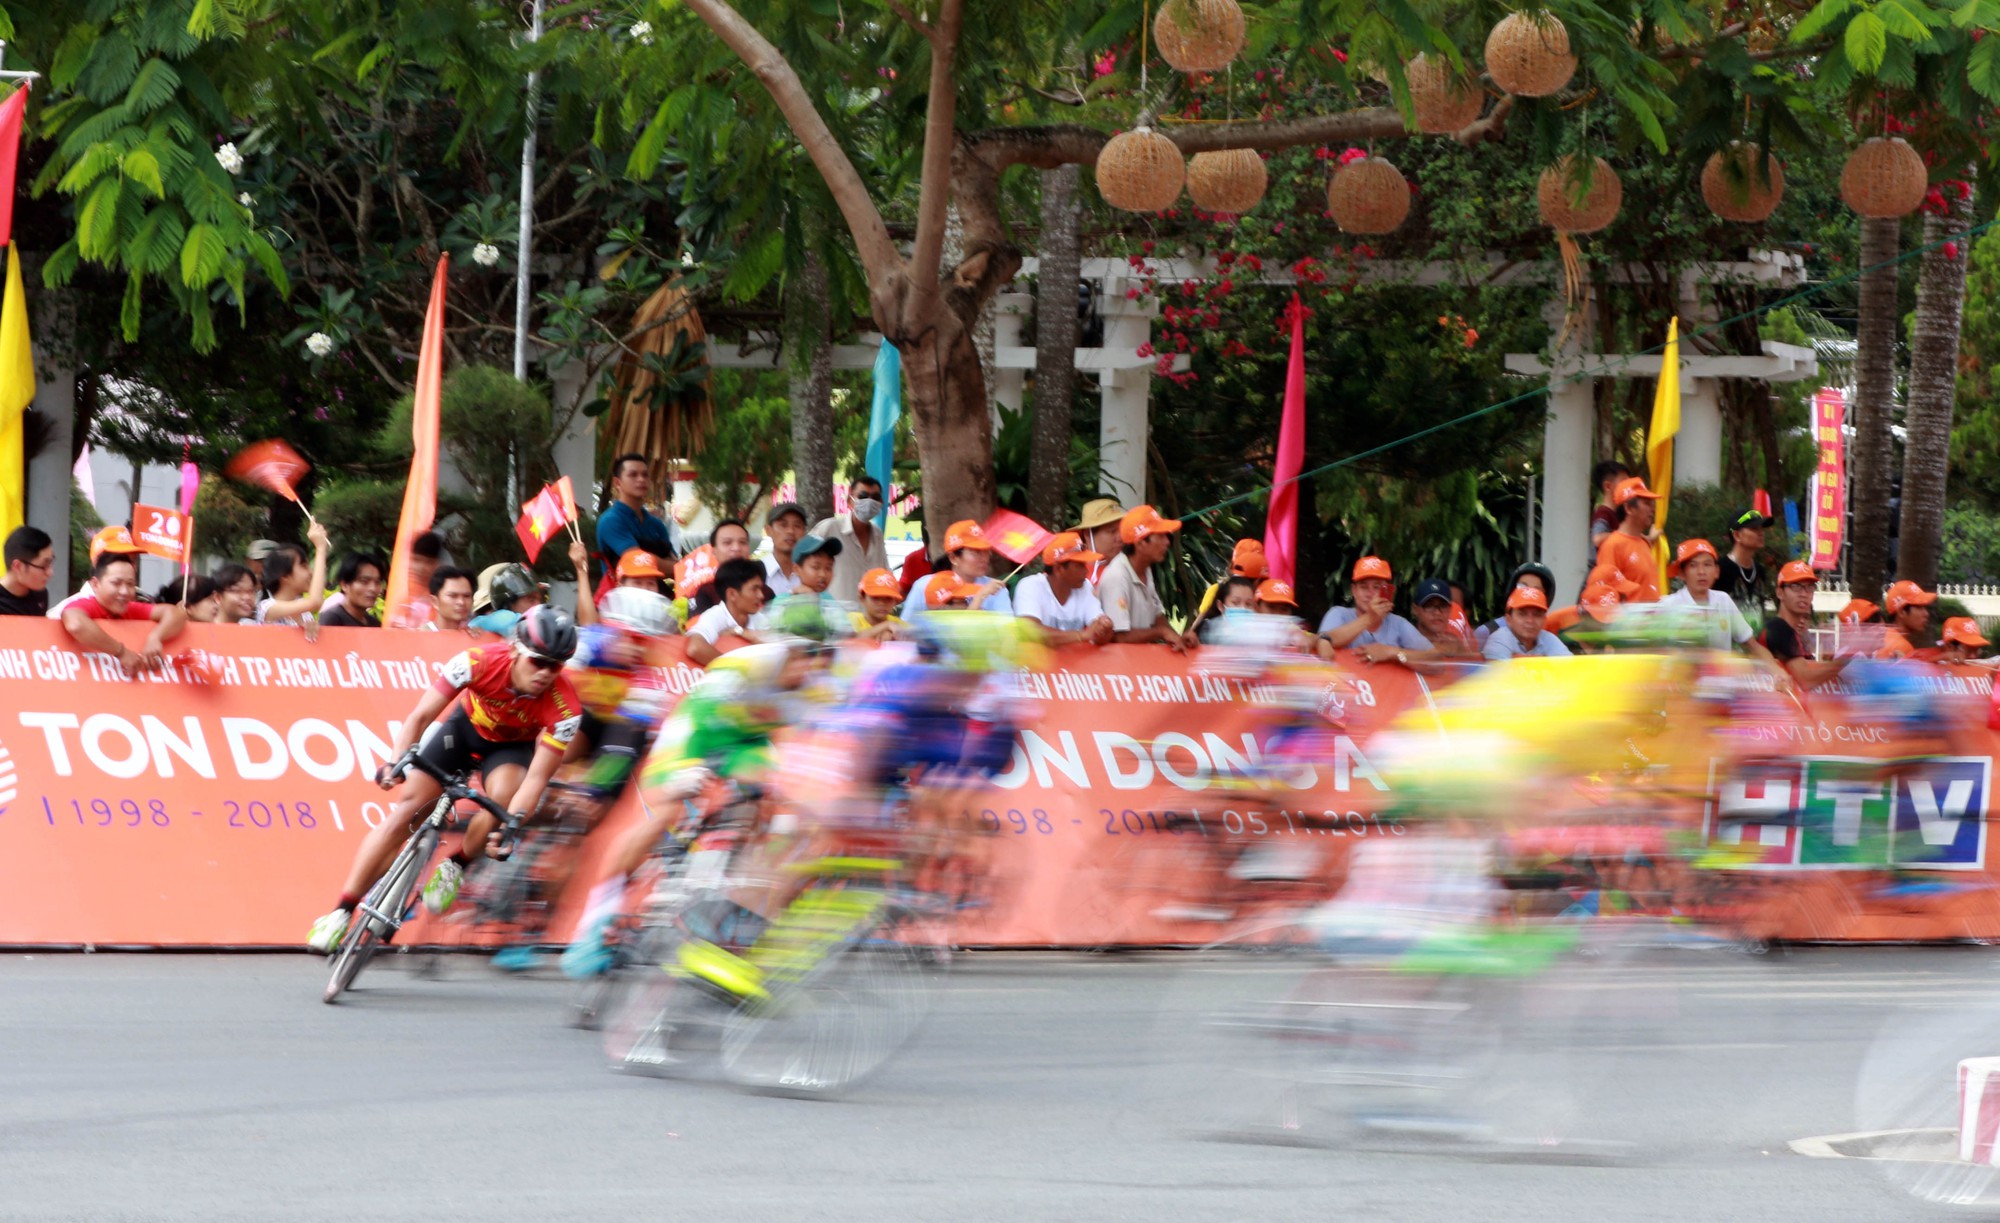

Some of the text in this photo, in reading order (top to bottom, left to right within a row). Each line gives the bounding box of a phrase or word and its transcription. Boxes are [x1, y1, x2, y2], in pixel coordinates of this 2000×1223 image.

[33, 645, 80, 681] CÚP
[240, 655, 333, 688] TP.HCM
[331, 650, 383, 690] LẦN
[381, 655, 432, 691] THỨ
[1051, 668, 1108, 701] HÌNH
[1104, 674, 1190, 703] TP.HCM
[1186, 668, 1233, 703] LẦN
[18, 711, 440, 783] TON DON
[989, 729, 1093, 790] ON
[1334, 735, 1391, 791] A
[71, 799, 171, 828] 1998
[223, 800, 318, 830] 2018
[1717, 779, 1975, 847] HTV
